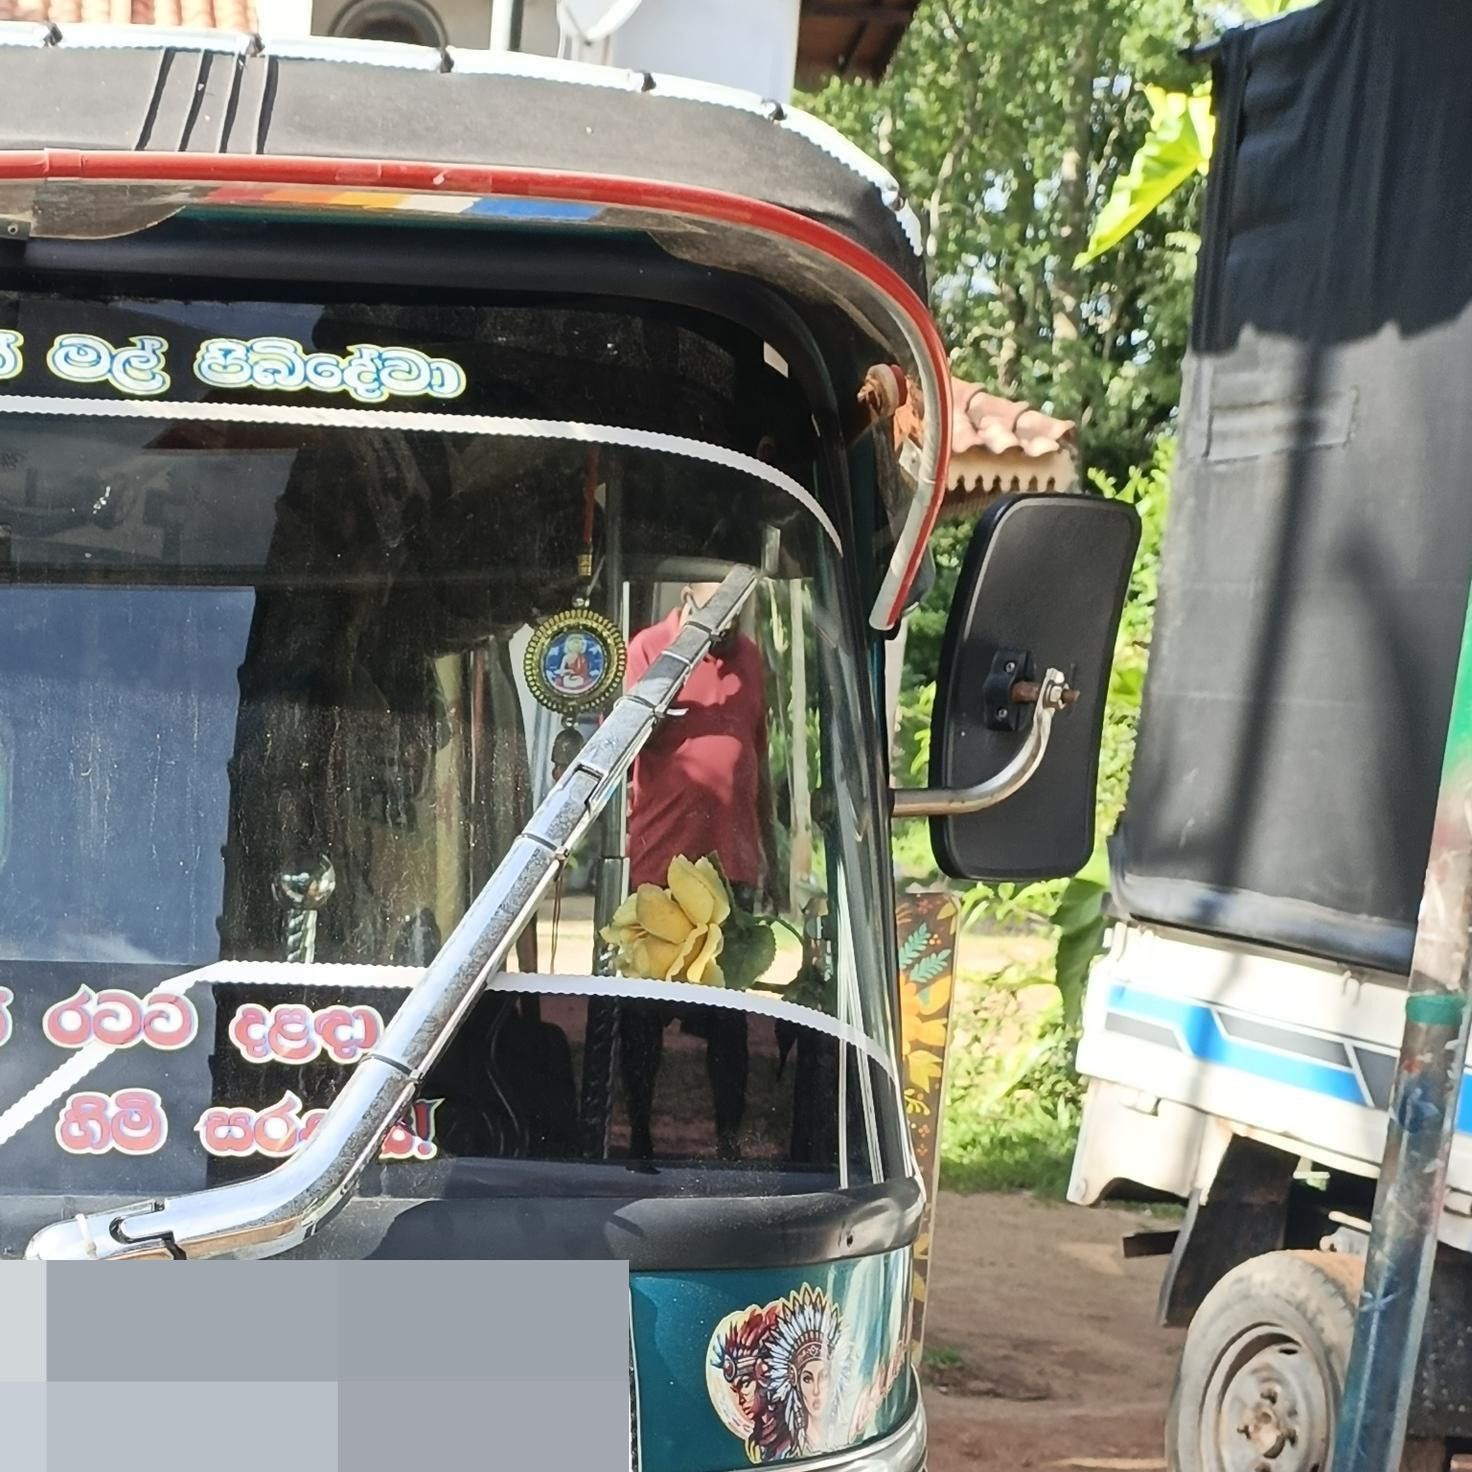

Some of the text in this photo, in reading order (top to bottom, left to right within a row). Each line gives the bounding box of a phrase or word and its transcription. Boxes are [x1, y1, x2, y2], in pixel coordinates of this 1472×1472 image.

[47, 333, 171, 395] මල්
[43, 984, 198, 1049] රටට
[55, 1088, 168, 1155] හිමි
